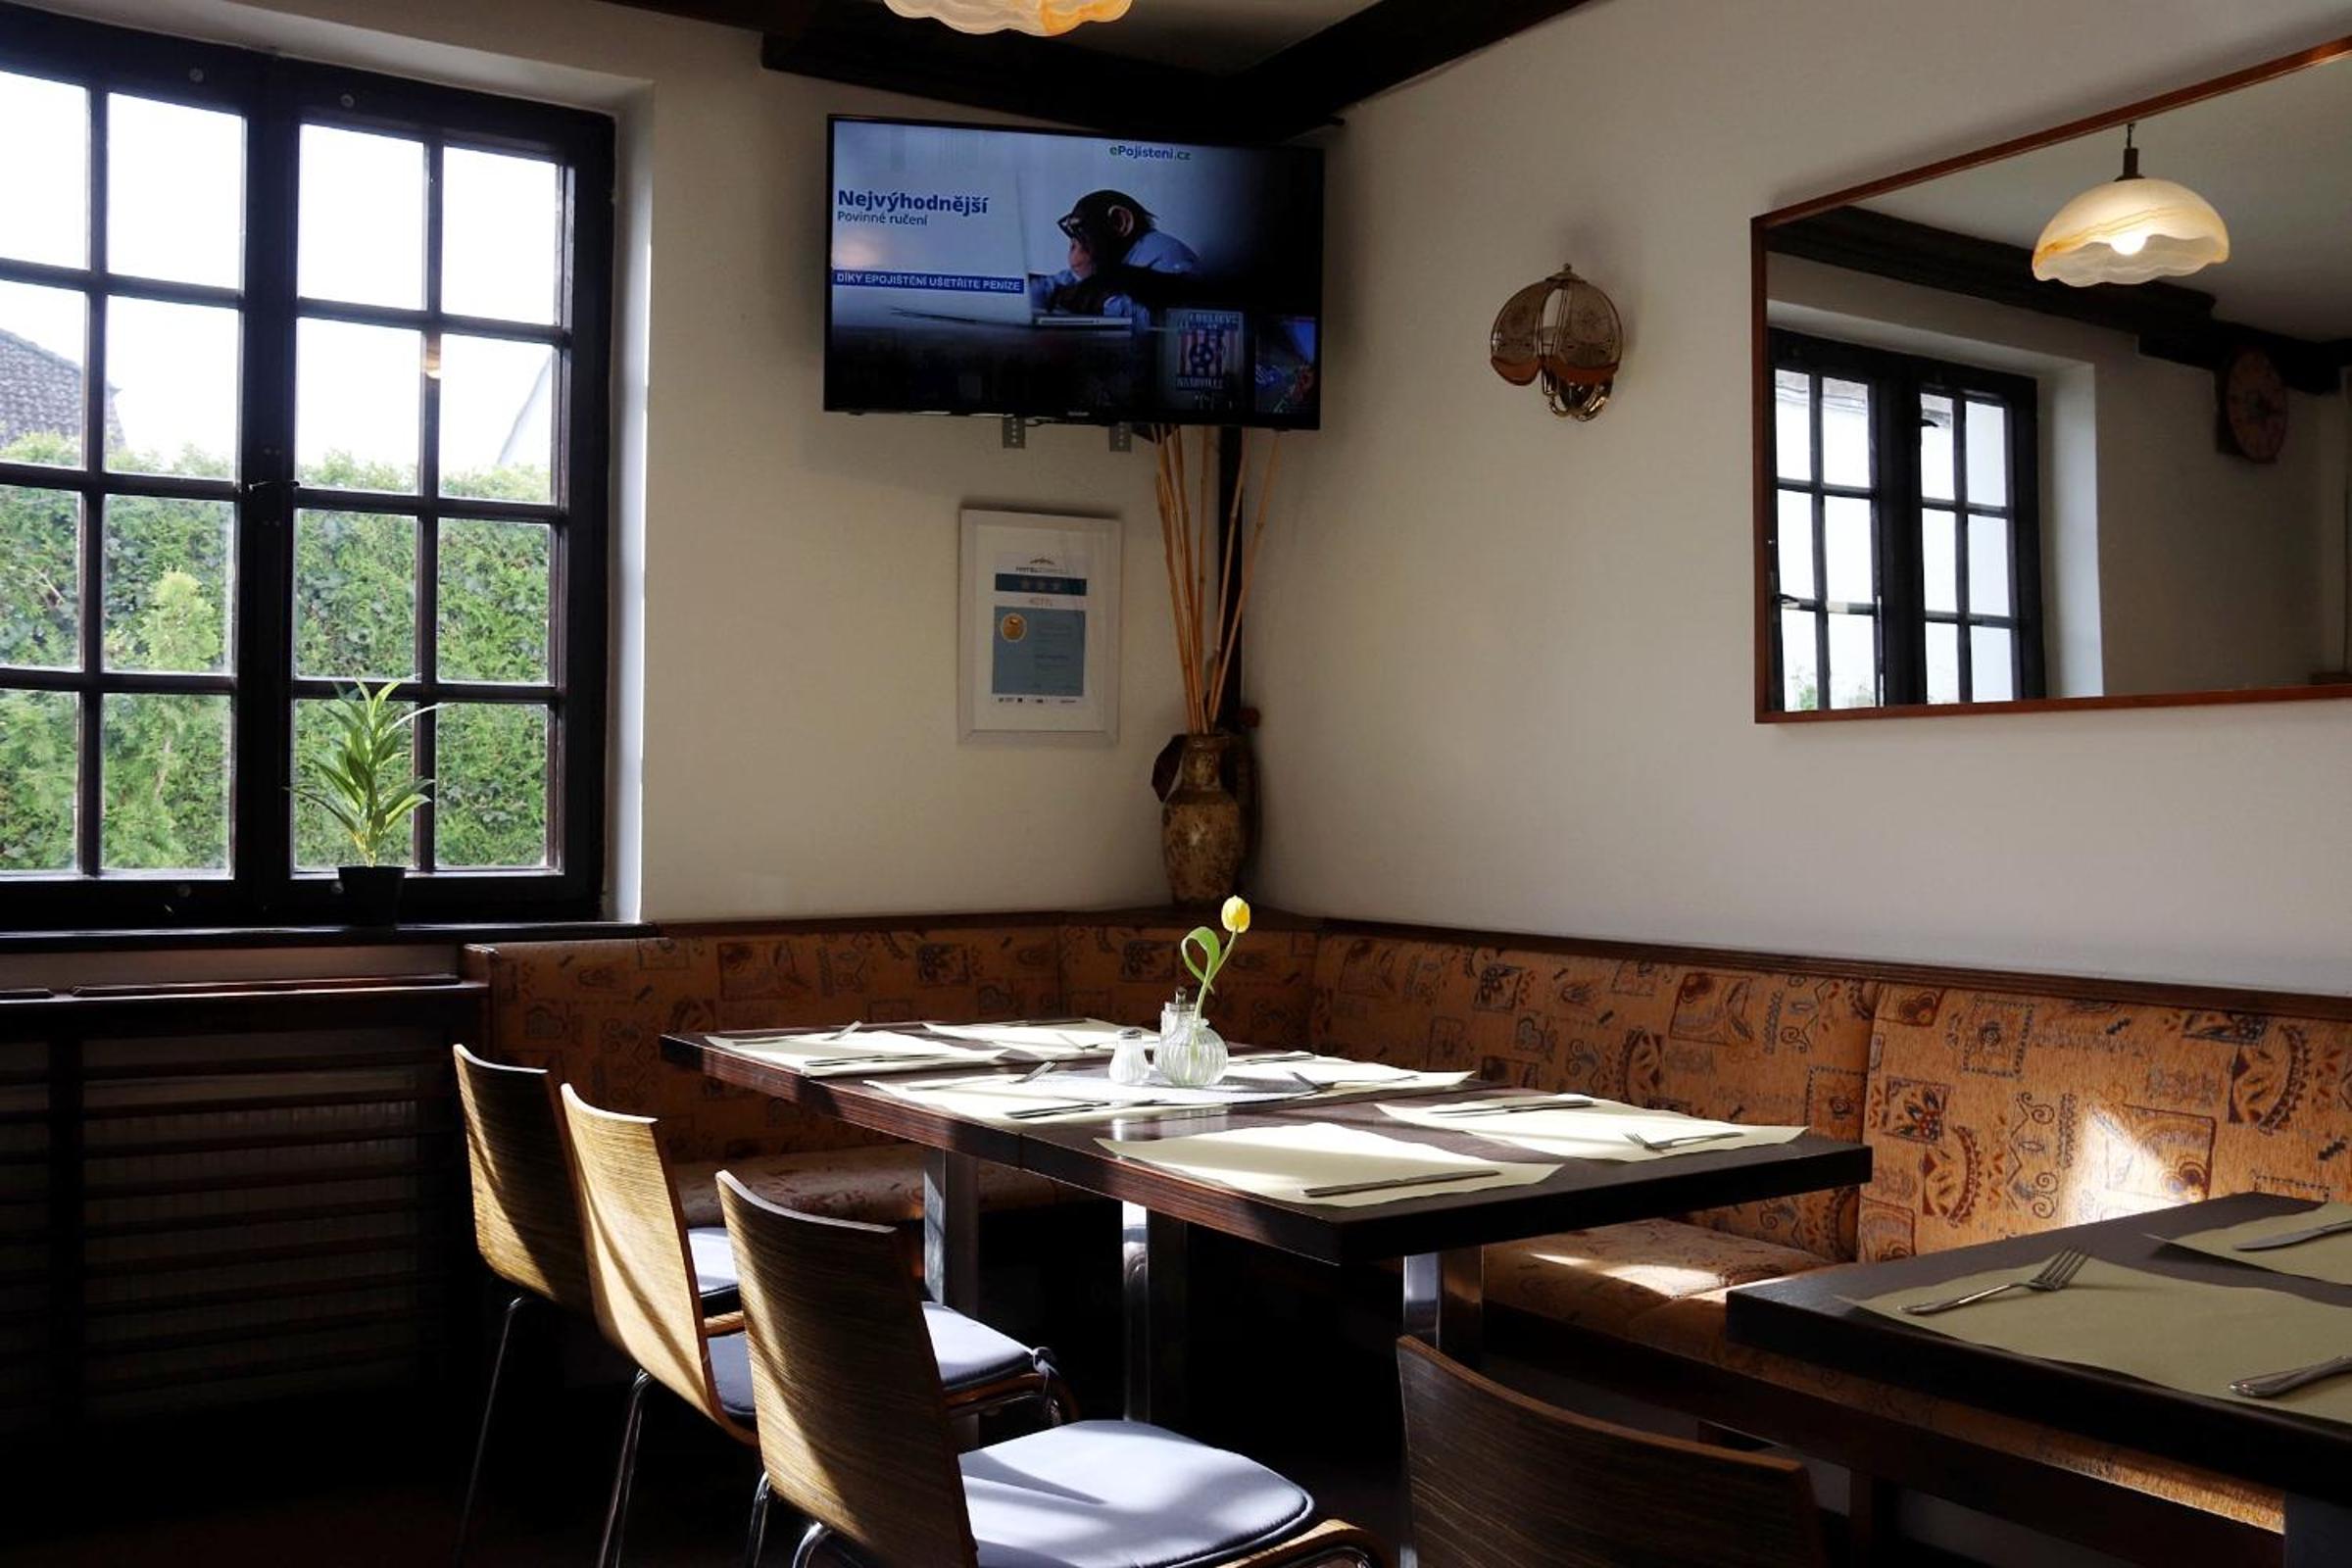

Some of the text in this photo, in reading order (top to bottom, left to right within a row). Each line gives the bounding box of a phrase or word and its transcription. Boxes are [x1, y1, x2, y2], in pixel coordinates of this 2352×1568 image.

[838, 189, 989, 216] Nejvýhodnější
[838, 210, 928, 226] Povinné ručení
